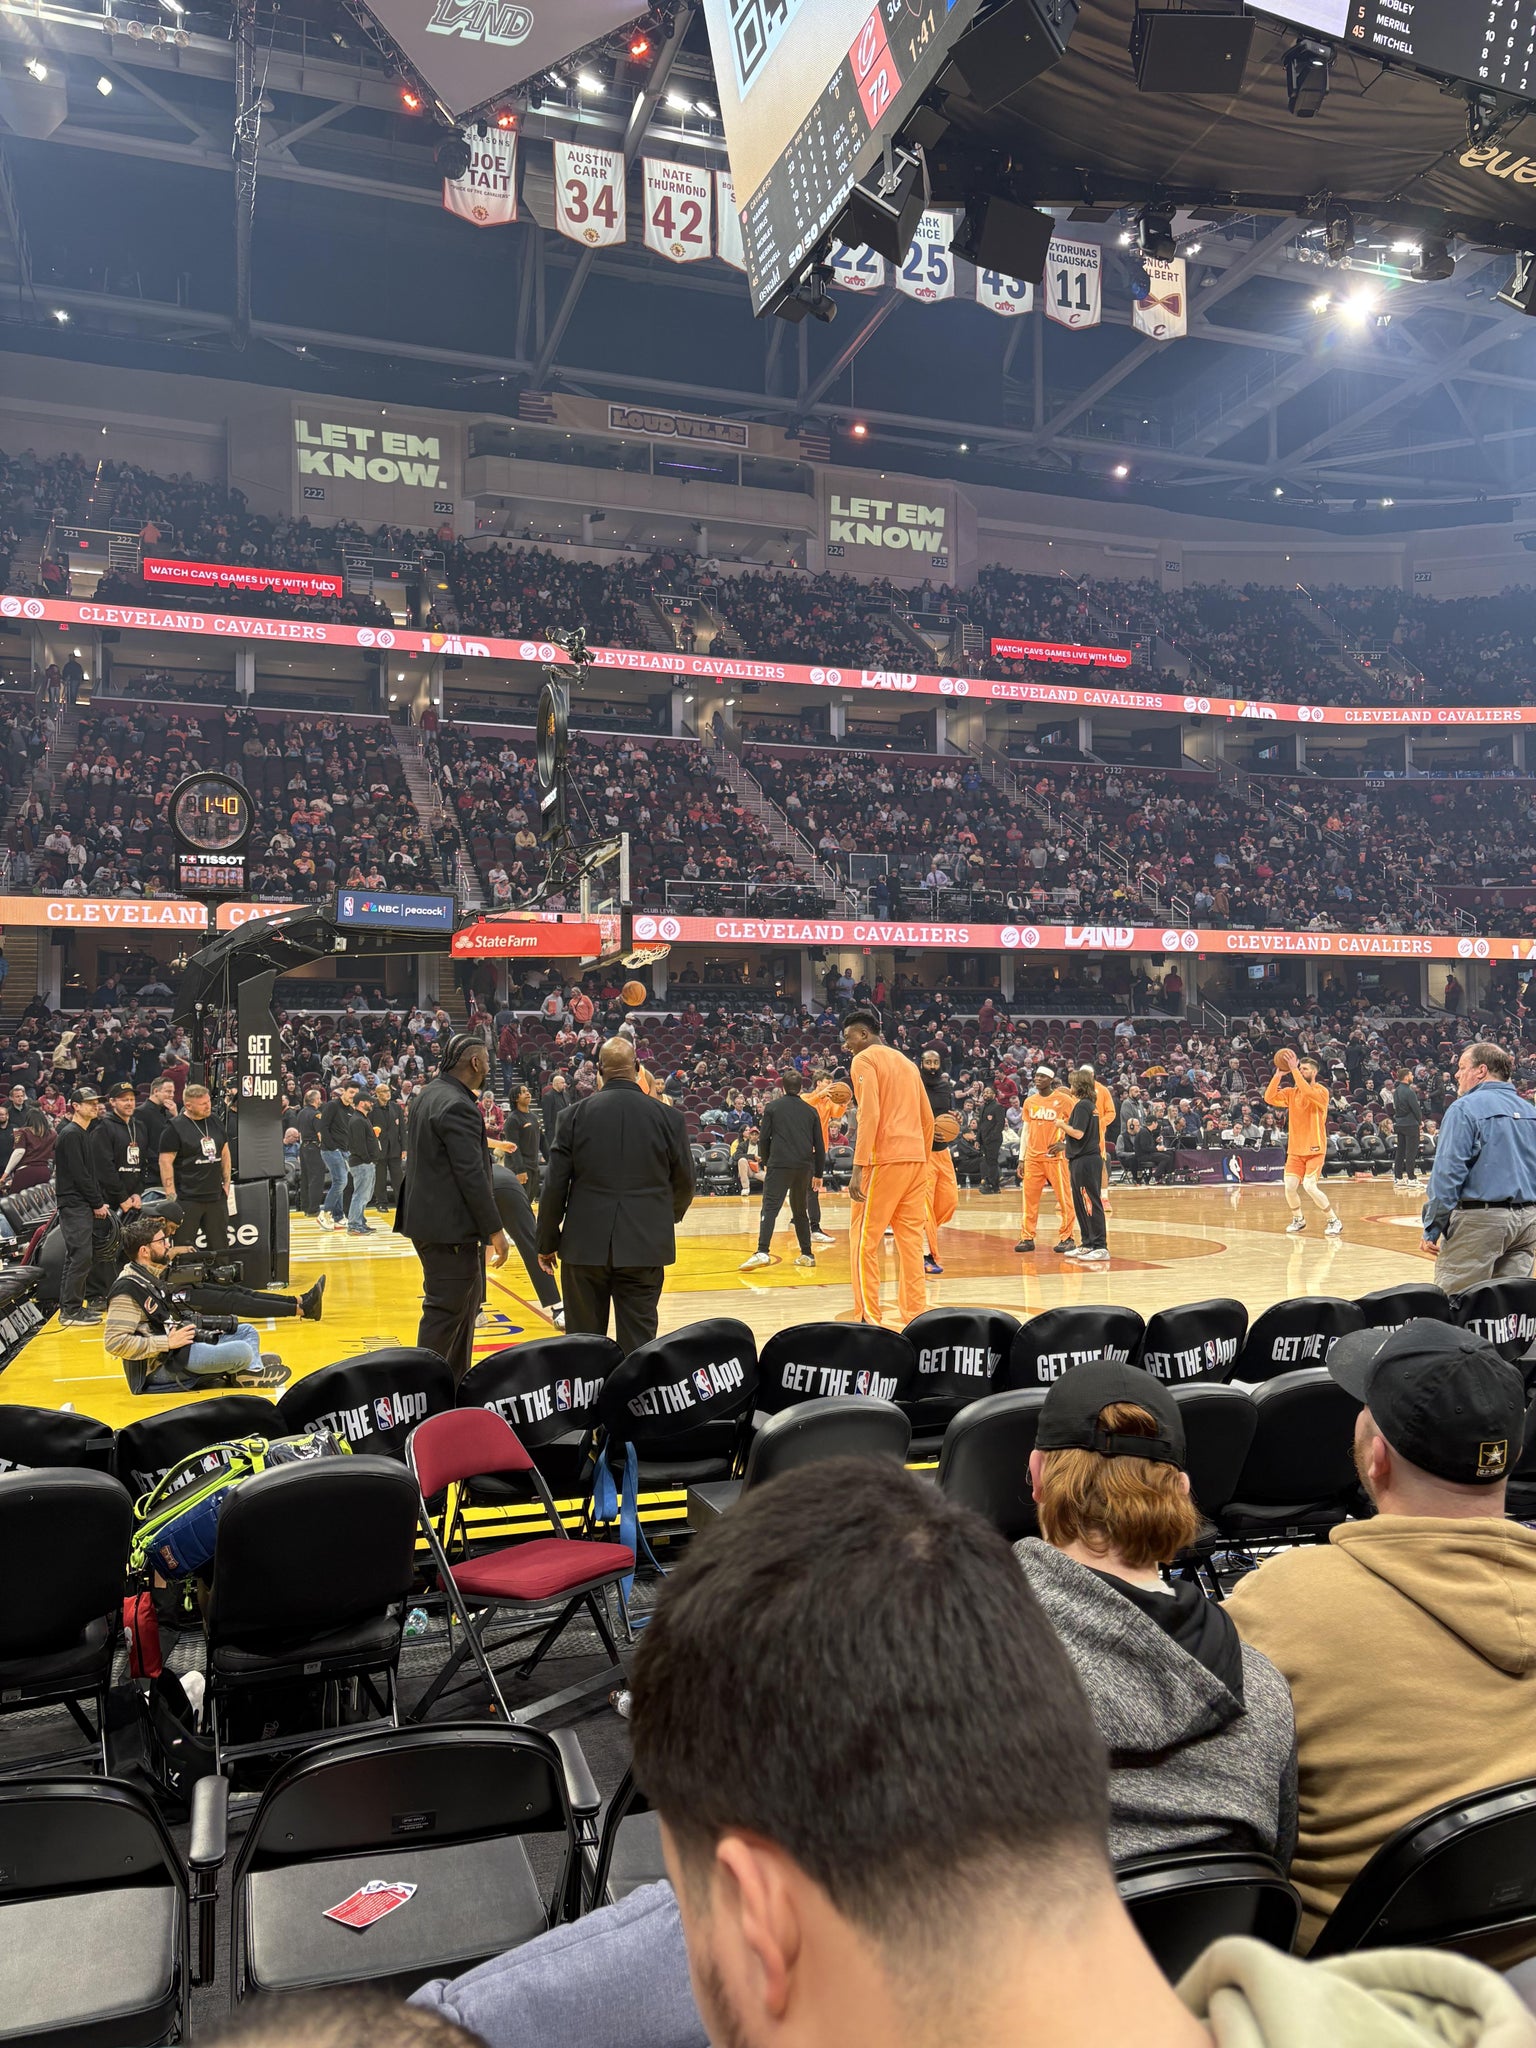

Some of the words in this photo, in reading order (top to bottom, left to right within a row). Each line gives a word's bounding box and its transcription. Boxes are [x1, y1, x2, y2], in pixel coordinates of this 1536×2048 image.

[426, 0, 534, 46] LAND
[1488, 12, 1496, 23] 3
[1510, 18, 1518, 30] 0
[909, 9, 935, 62] 1:41
[1358, 6, 1366, 18] 5
[1376, 14, 1410, 34] MERRILL
[1481, 48, 1488, 60] 8
[1504, 54, 1510, 66] 3
[1524, 61, 1530, 72] 1
[1484, 29, 1496, 42] 10
[1507, 36, 1514, 48] 6
[1526, 43, 1534, 55] 4
[1352, 25, 1365, 38] 45
[1373, 32, 1414, 55] MITCHELL
[1478, 66, 1488, 78] 16
[1500, 72, 1506, 84] 1
[1520, 79, 1528, 90] 2
[868, 68, 890, 116] 72
[472, 152, 506, 172] JOE
[568, 150, 612, 168] AUSTIN
[468, 170, 510, 192] TAIT
[574, 164, 608, 180] CARR
[662, 168, 692, 184] NATE
[648, 178, 706, 198] THURMOND
[564, 178, 618, 228] 34
[820, 173, 855, 228] RAFFLE
[652, 196, 703, 244] 42
[917, 216, 940, 228] ARK
[915, 228, 940, 240] RICE
[1050, 242, 1098, 258] ZYDRUNAS
[760, 249, 780, 276] MITCHELL
[903, 240, 948, 286] 25
[1049, 254, 1098, 270] ILGAUSKAS
[759, 266, 780, 302] oswald
[1145, 268, 1180, 282] LBERT
[1056, 269, 1091, 312] 11
[611, 406, 746, 445] LOUDVILLE
[295, 419, 376, 451] LET
[382, 431, 440, 460] EM
[297, 448, 448, 490] KNOW.
[304, 488, 324, 498] 222
[434, 502, 453, 513] 223
[830, 495, 892, 520] LET
[897, 502, 944, 528] EM
[64, 530, 79, 538] 221
[830, 520, 948, 554] KNOW.
[828, 546, 844, 556] 224
[932, 558, 948, 566] 225
[150, 564, 188, 577] WATCH
[190, 568, 218, 580] CAVS
[220, 572, 258, 583] GAMES
[260, 576, 280, 586] LIVE
[282, 578, 309, 589] WITH
[310, 579, 336, 590] fubo
[1416, 573, 1431, 582] 227
[78, 606, 205, 630] CLEVELAND
[214, 618, 327, 640] CAVALIERS
[588, 650, 685, 672] LEVELAND
[692, 660, 786, 680] CAVALIERS
[996, 644, 1022, 654] WATCH
[1024, 646, 1044, 656] CAVS
[1044, 648, 1071, 658] GAMES
[1072, 652, 1088, 660] LIVE
[1088, 652, 1108, 661] WITH
[1108, 653, 1126, 663] fubo
[861, 670, 918, 692] LAND
[992, 684, 1078, 702] CLEVELAND
[1084, 692, 1163, 708] CAVALIERS
[1344, 711, 1432, 722] CLEVELAND
[1438, 710, 1522, 722] CAVALIERS
[206, 796, 238, 815] 1:40
[198, 855, 246, 866] TISSOT
[42, 886, 78, 896] Huntington
[259, 894, 293, 903] Huntington
[378, 905, 399, 914] NBC
[404, 905, 443, 918] peacock
[715, 922, 844, 940] CLEVELAND
[853, 926, 969, 943] CAVALIERS
[1064, 926, 1134, 948] LAND
[1226, 934, 1332, 951] CLEVELAND
[1338, 938, 1434, 954] CAVALIERS
[248, 1034, 272, 1054] GET
[248, 1056, 272, 1074] THE
[254, 1076, 278, 1100] App
[1144, 1352, 1172, 1380] GET
[1174, 1348, 1202, 1376] THE
[1215, 1336, 1238, 1366] App
[1271, 1336, 1300, 1362] GET
[1300, 1334, 1324, 1360] THE
[919, 1347, 950, 1374] GET
[952, 1346, 983, 1377] THE
[1036, 1352, 1068, 1382] GET
[628, 1387, 660, 1417] GET
[659, 1378, 696, 1414] THE
[708, 1357, 744, 1394] App
[782, 1362, 817, 1392] GET
[820, 1366, 852, 1396] THE
[869, 1371, 898, 1401] App
[483, 1396, 520, 1425] GET
[523, 1390, 554, 1424] THE
[574, 1376, 604, 1410] App
[304, 1411, 345, 1437] GET
[338, 1407, 374, 1442] THE
[392, 1391, 427, 1430] App
